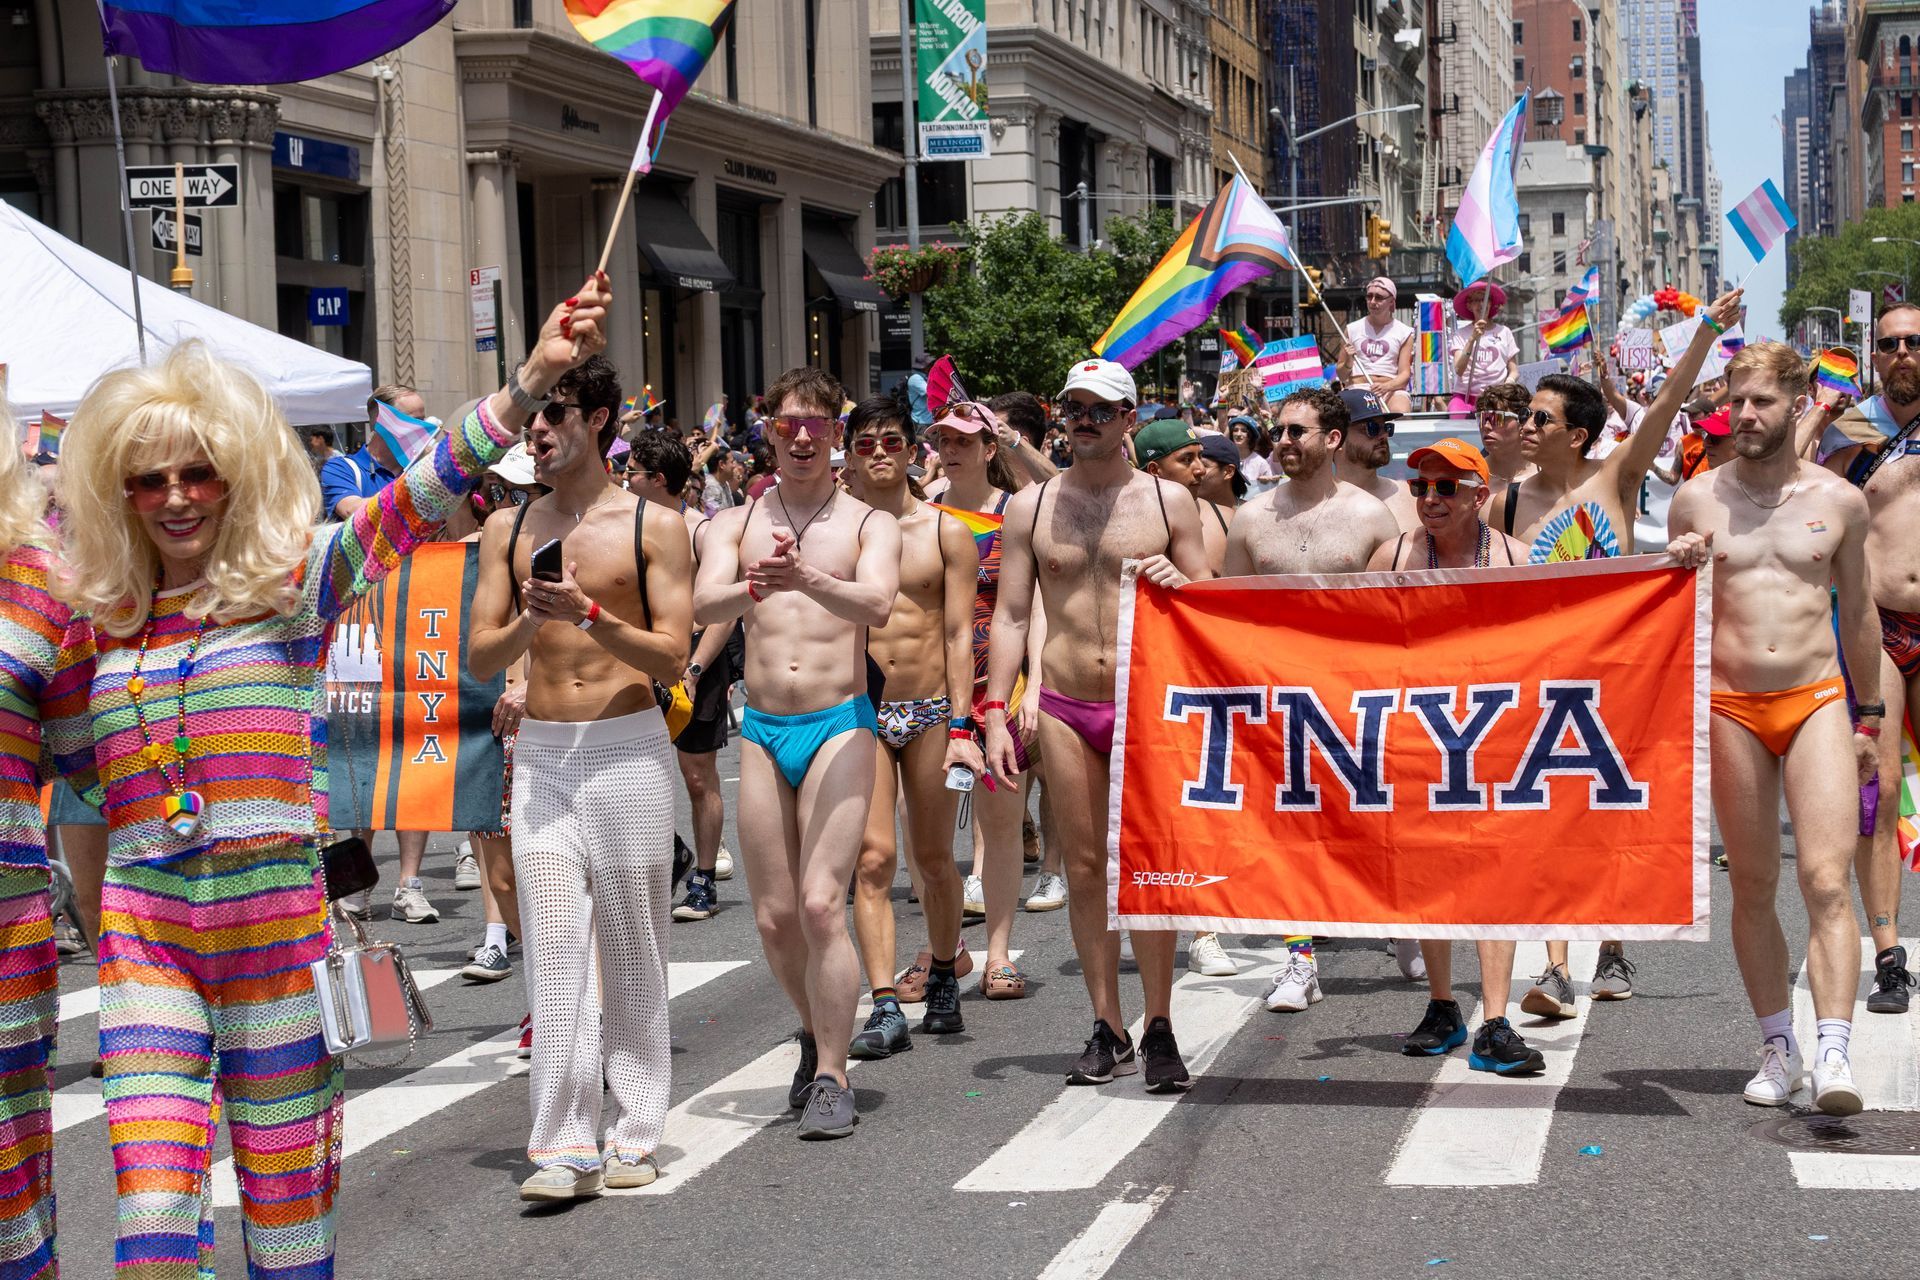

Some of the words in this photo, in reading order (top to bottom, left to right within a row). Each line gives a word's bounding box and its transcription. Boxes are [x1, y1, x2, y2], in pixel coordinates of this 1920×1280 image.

[926, 70, 979, 121] NOMAD
[724, 158, 745, 177] CLUB
[746, 164, 777, 185] MONACO
[140, 180, 172, 196] ONE
[188, 178, 221, 195] WAY
[159, 221, 174, 239] ONE
[680, 276, 692, 288] CLUB
[693, 278, 713, 290] MONACO
[317, 297, 342, 316] GAP
[1855, 305, 1864, 314] 24
[1272, 340, 1299, 353] OUR
[1258, 348, 1313, 367] EXISTENCE
[1283, 362, 1294, 370] IS
[1898, 420, 1920, 441] adidas
[1869, 448, 1892, 472] adidas
[1814, 686, 1840, 700] arena
[1163, 679, 1650, 812] TNYA
[1131, 868, 1196, 889] speedo
